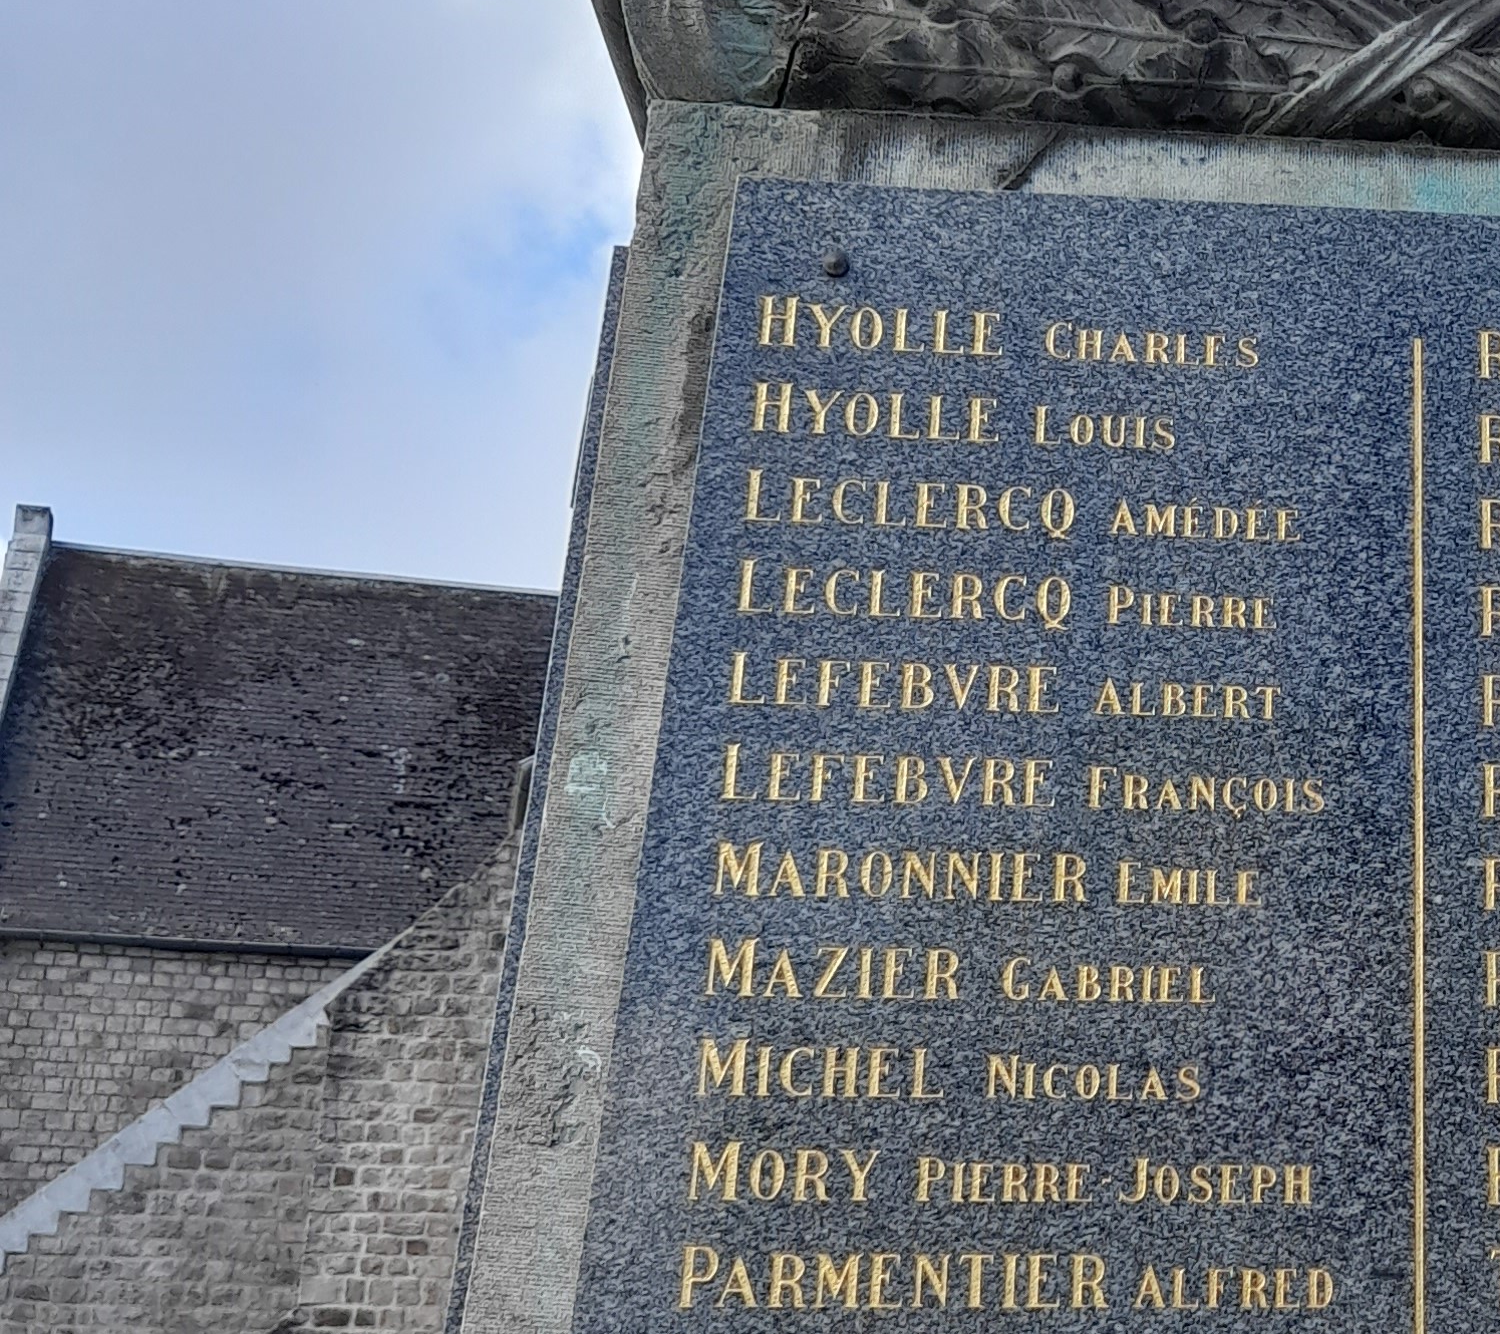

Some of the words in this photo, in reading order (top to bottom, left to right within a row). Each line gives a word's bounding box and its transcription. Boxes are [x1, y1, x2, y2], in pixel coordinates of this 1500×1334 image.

[758, 295, 1004, 358] HYOLLE
[1045, 322, 1260, 368] CHARLES
[751, 381, 1001, 444] HYOLLE
[1035, 406, 1178, 450] LOUIS
[743, 469, 1076, 539] LECLERCQ
[1110, 499, 1301, 543] AMÉDÉE
[736, 559, 1072, 629] LECLERCQ
[1108, 584, 1278, 630] PIERRE
[728, 652, 1061, 715] LEFEBVRE
[1095, 677, 1282, 720] ALBERT
[720, 745, 1056, 809] LEFEBVRE
[1088, 766, 1326, 817] FRANÇOIS
[712, 842, 1088, 905] MARONNIER
[703, 938, 961, 1001] MAZIER
[1002, 956, 1216, 1005] GABRIEL
[695, 1038, 945, 1098] MICHEL
[986, 1054, 1201, 1101] NICOLAS
[686, 1141, 881, 1203] MORY
[676, 1246, 1109, 1311] PARMENTIER
[1132, 1265, 1336, 1310] ALFRED
